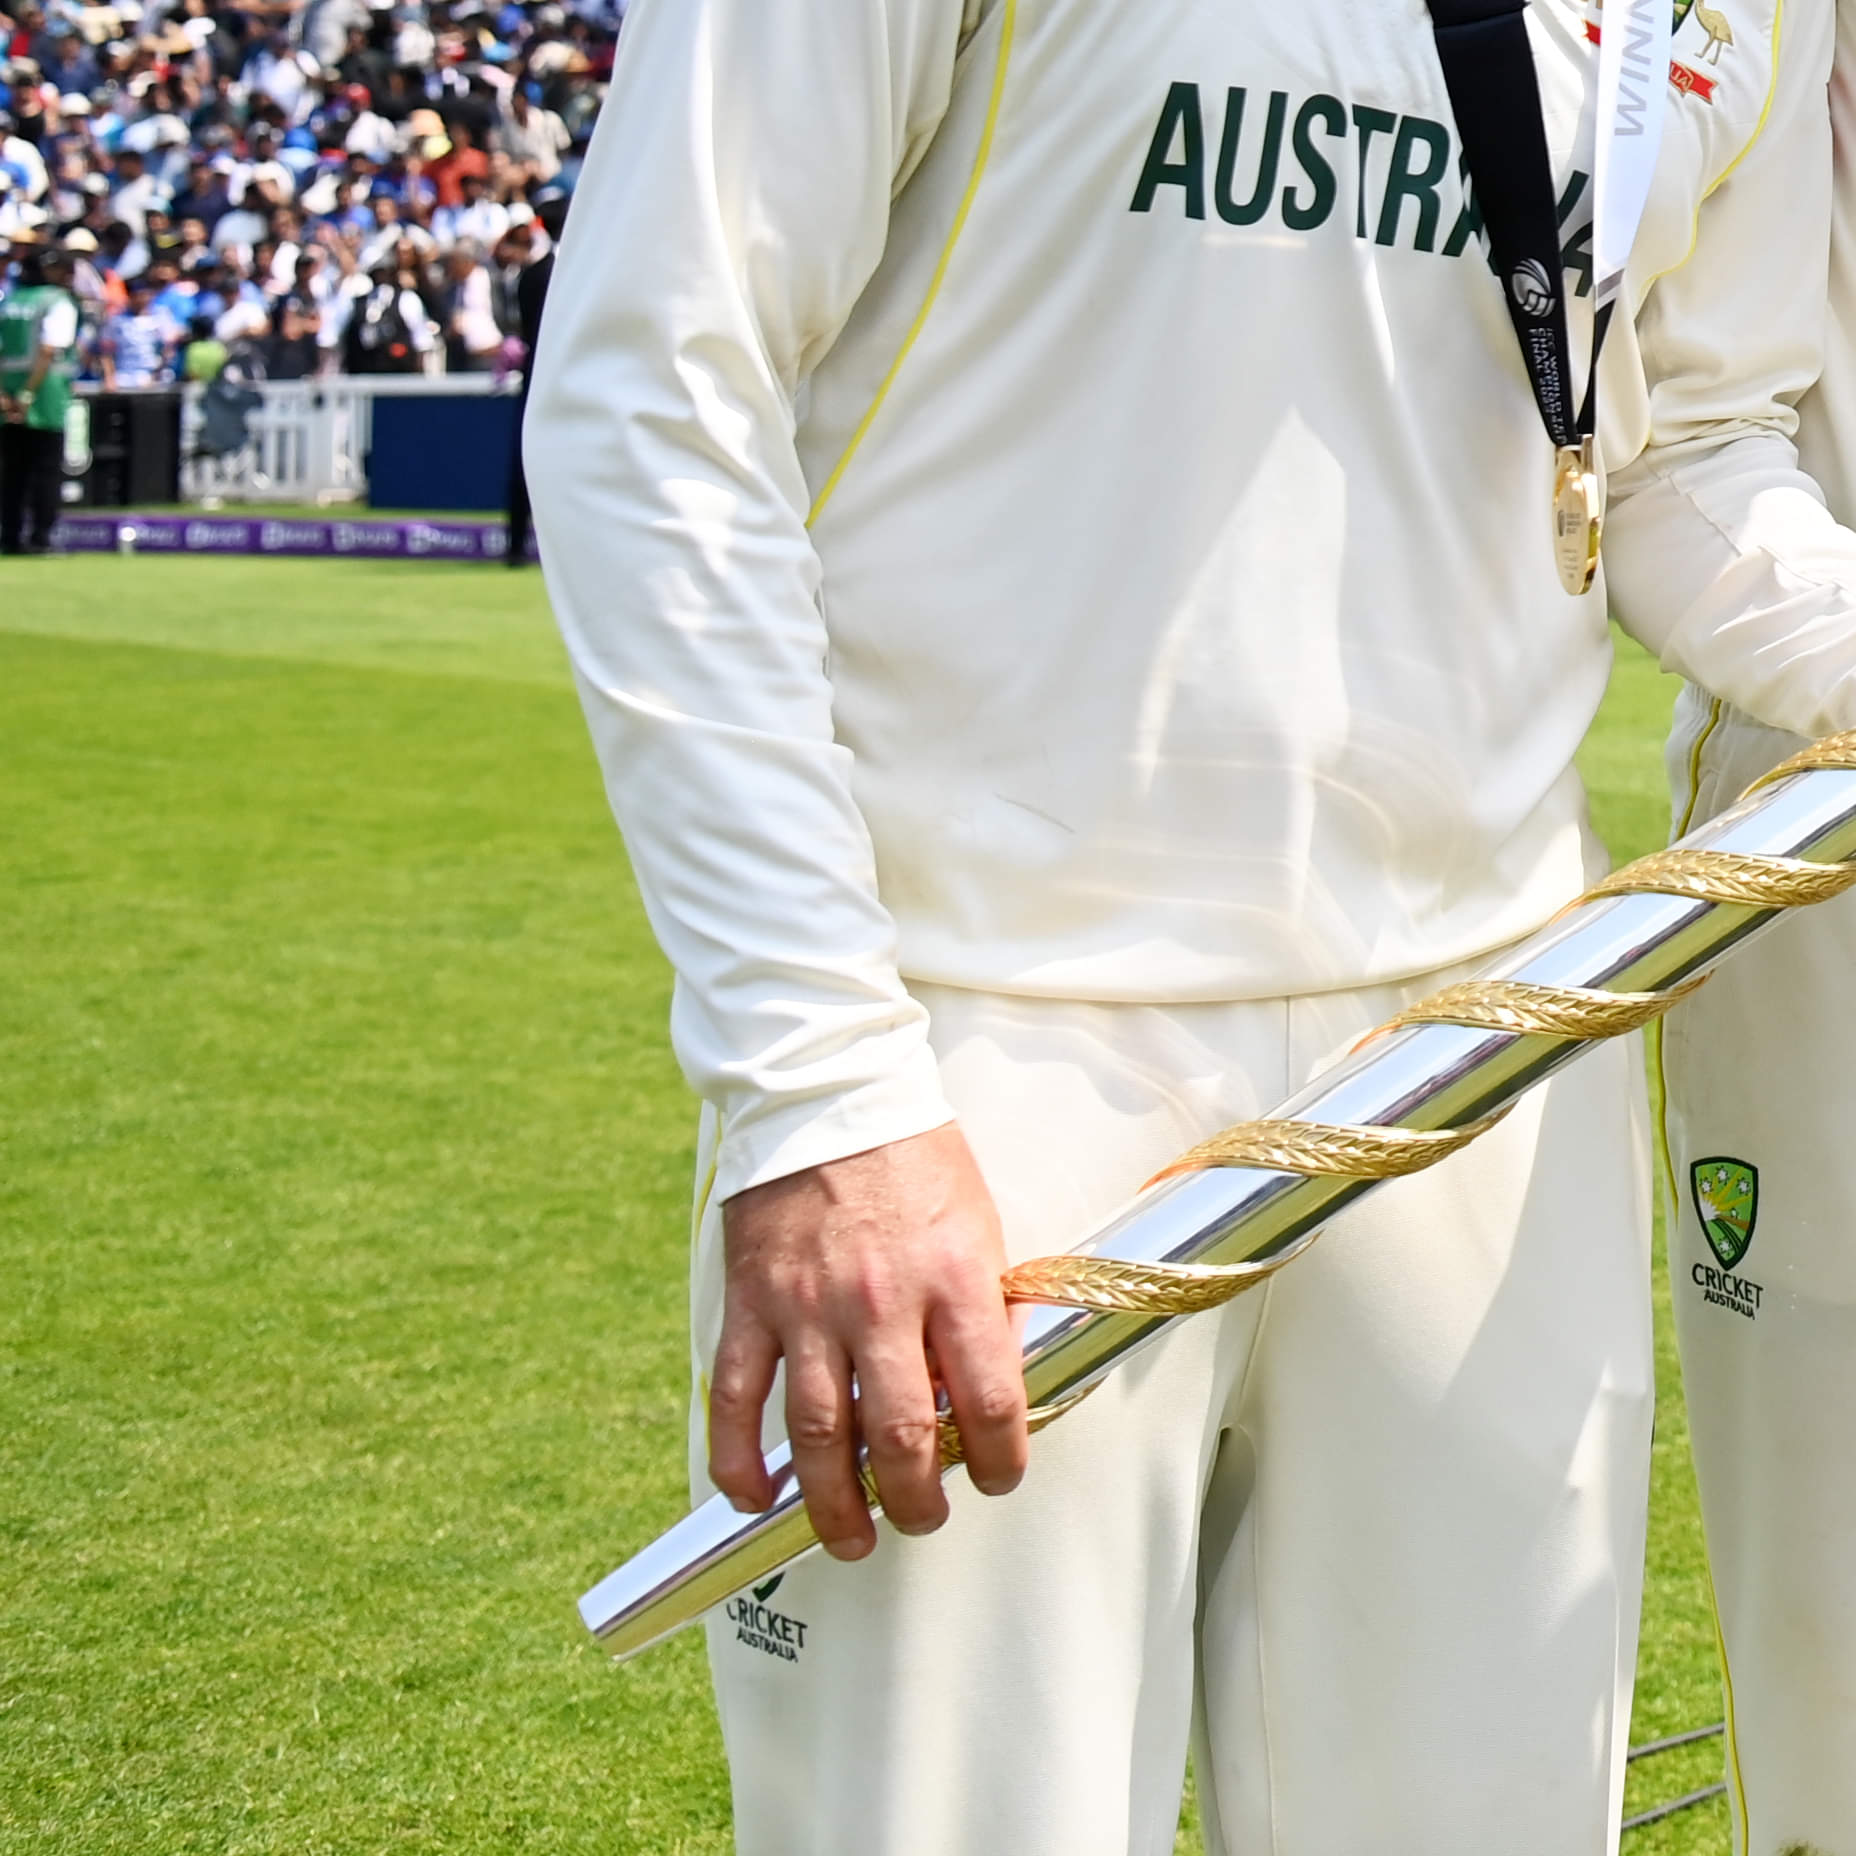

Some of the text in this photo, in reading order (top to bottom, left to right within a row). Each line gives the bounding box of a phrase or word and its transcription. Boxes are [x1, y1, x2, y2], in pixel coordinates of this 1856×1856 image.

[1692, 1263, 1763, 1308] CRICKET
[1704, 1289, 1755, 1321] AUSTRALIA
[726, 1597, 808, 1648] CRICKET
[736, 1627, 798, 1663] AUSTRALIA
